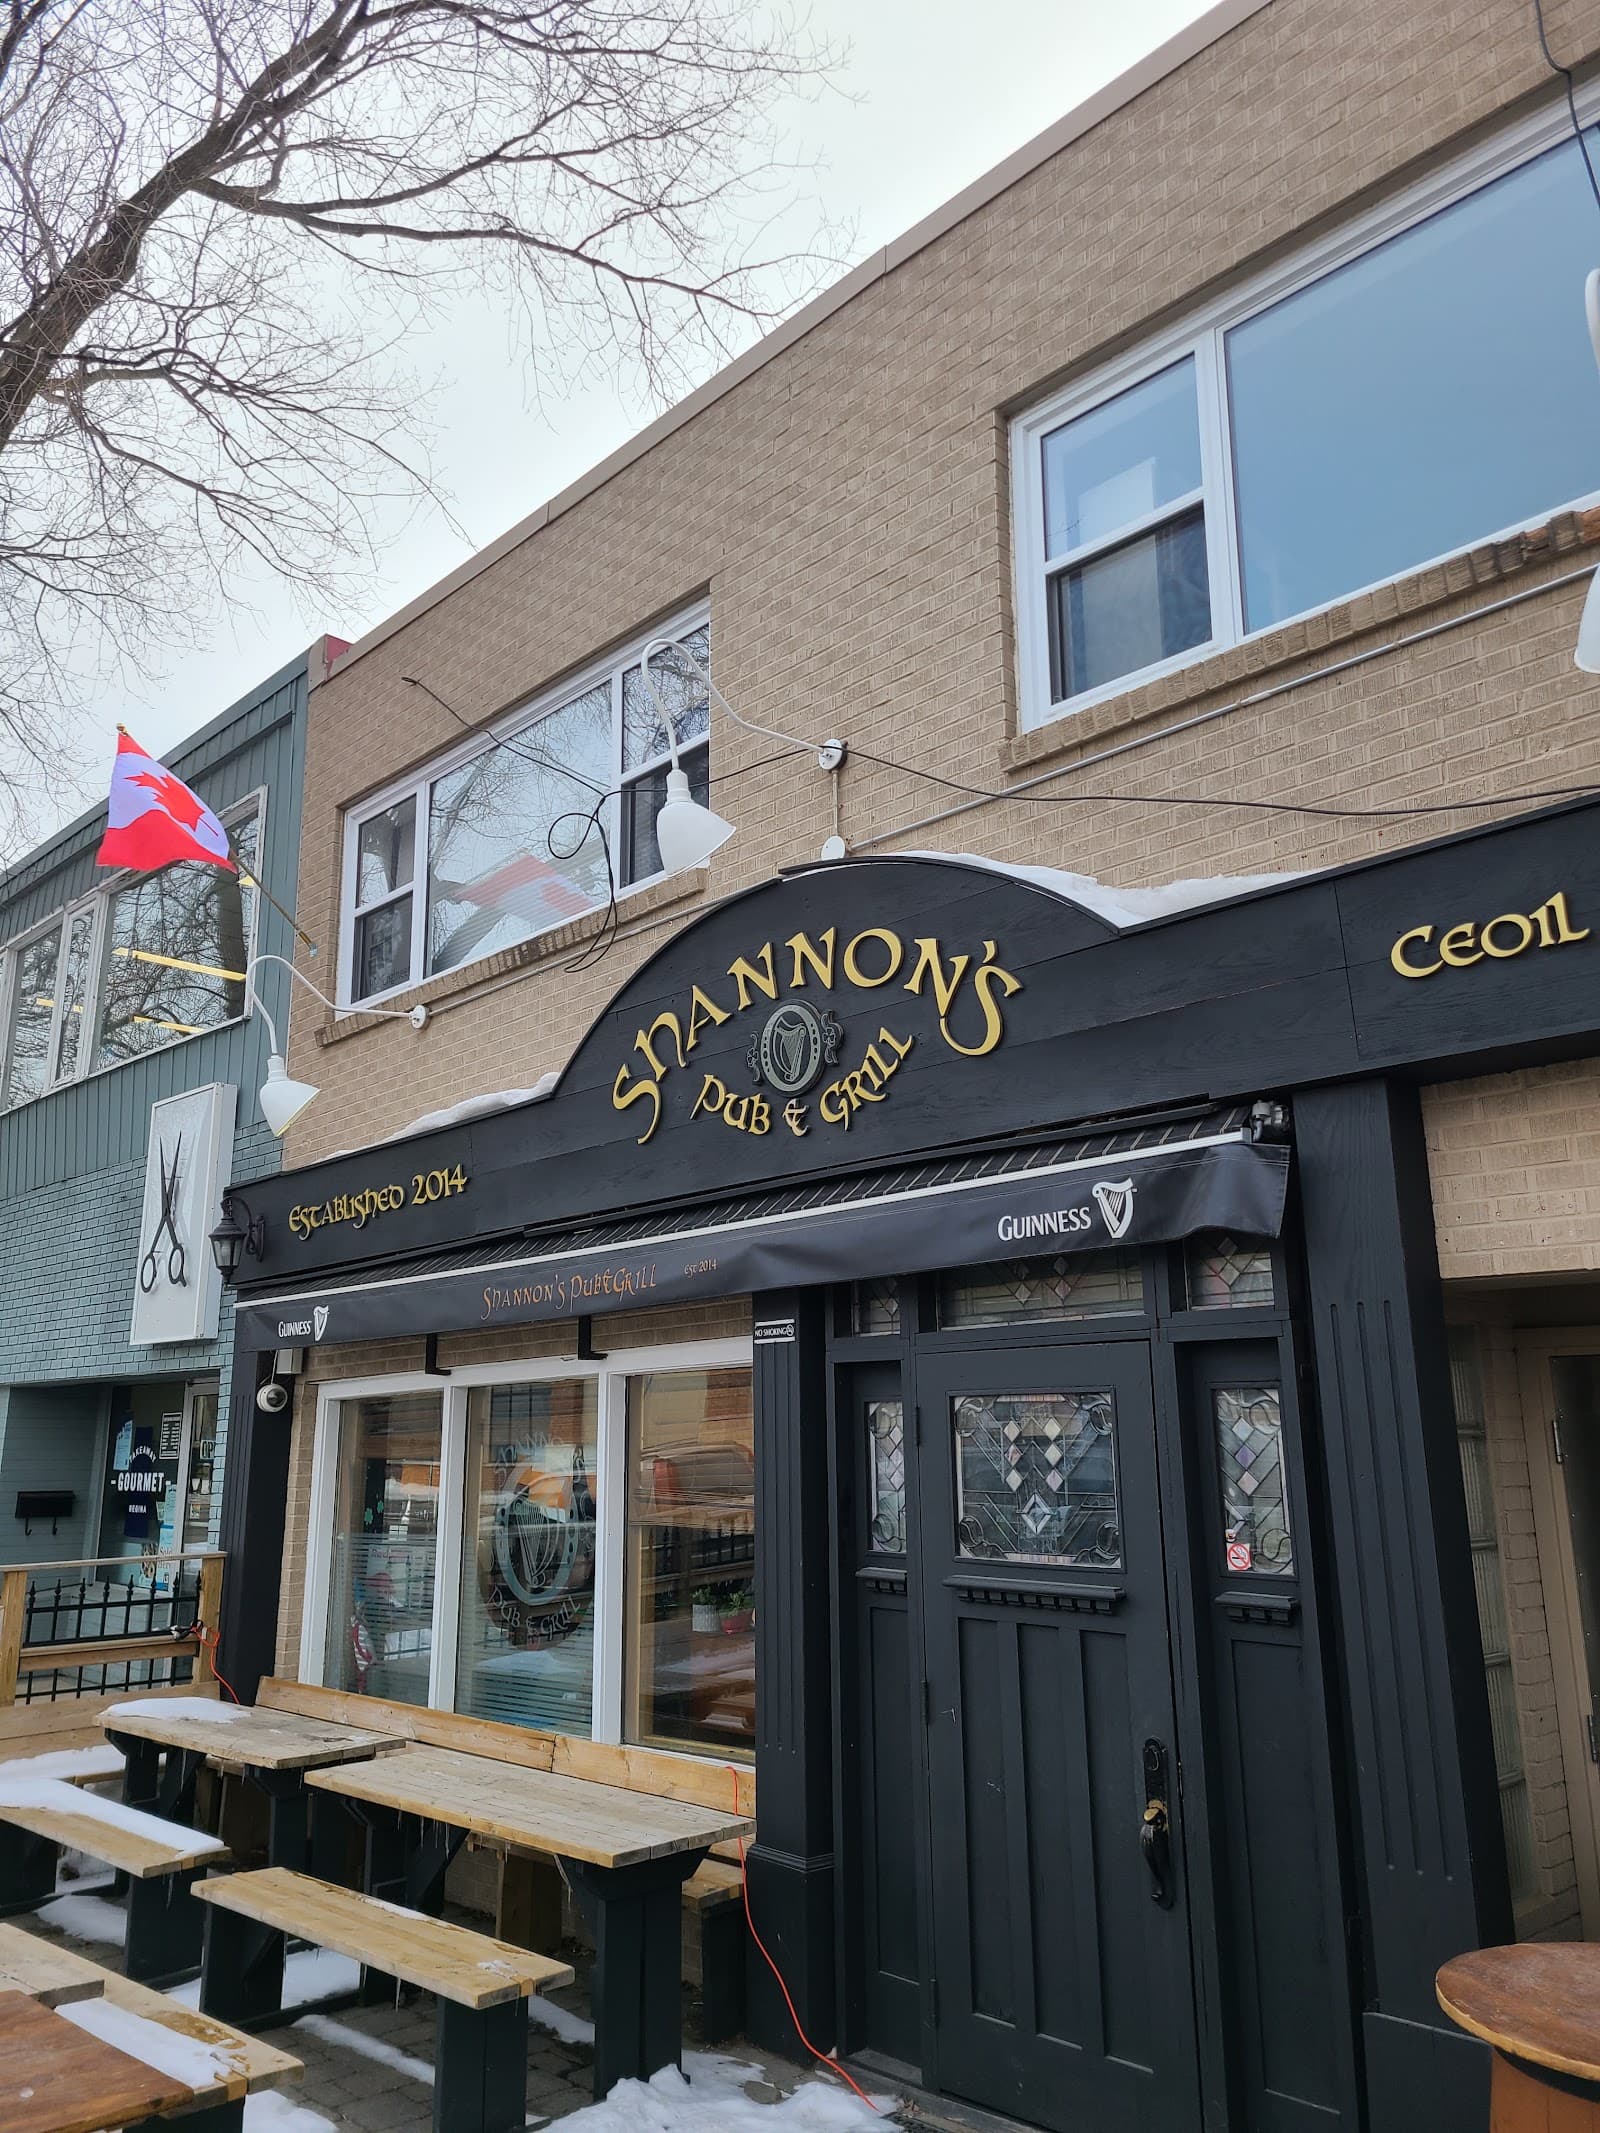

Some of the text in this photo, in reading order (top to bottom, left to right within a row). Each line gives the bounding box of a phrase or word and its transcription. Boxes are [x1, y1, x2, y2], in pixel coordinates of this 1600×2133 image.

[1390, 891, 1590, 978] CEOIL
[689, 1026, 914, 1137] PUB & GRILL
[412, 1163, 468, 1205] 2014
[698, 1258, 717, 1273] 2014
[754, 1326, 787, 1337] NO SMOKING
[129, 1445, 156, 1463] TAKEAWAY
[118, 1472, 165, 1492] GOURMET
[128, 1504, 147, 1514] REGINA
